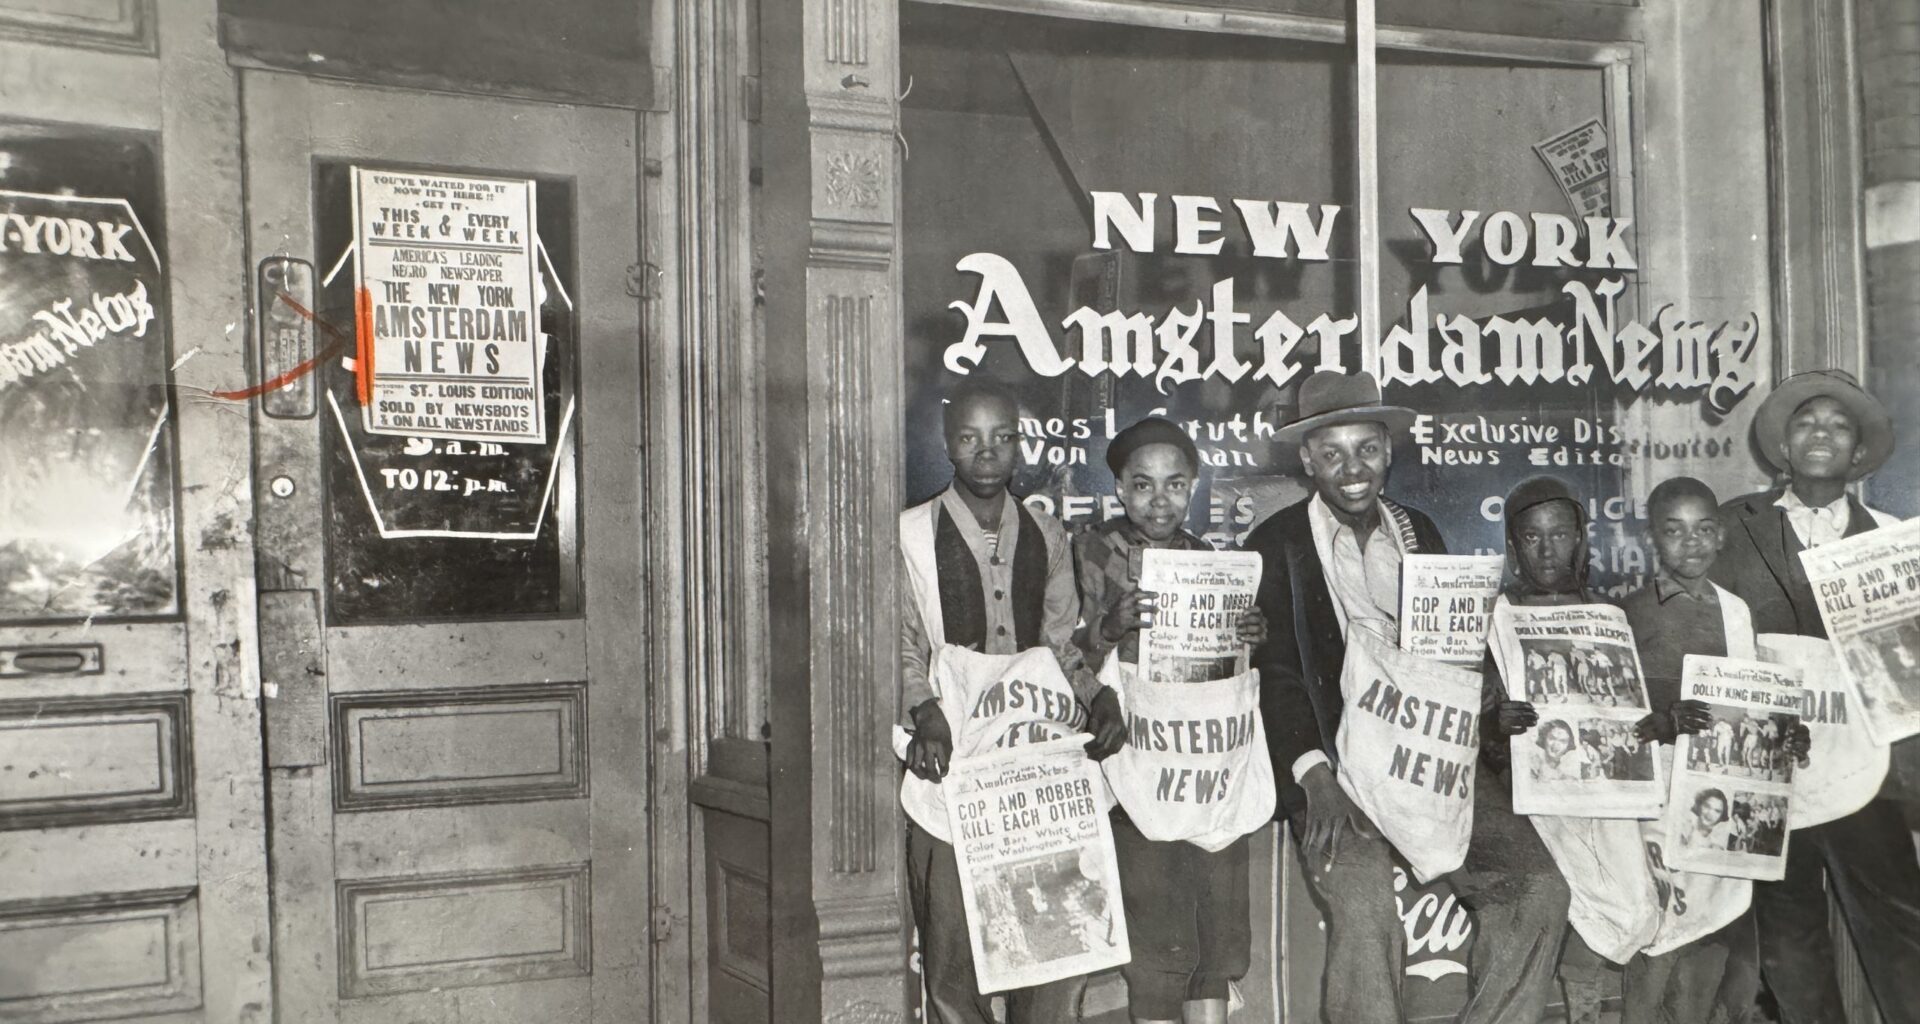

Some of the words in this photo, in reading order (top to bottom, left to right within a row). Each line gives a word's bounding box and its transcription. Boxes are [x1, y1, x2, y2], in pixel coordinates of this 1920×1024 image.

[373, 175, 414, 187] YOU'VE
[420, 180, 464, 190] WAITED
[469, 183, 490, 192] FOR
[495, 185, 506, 194] IT
[394, 187, 421, 195] NOW
[426, 189, 446, 198] IT'S
[453, 191, 483, 201] HERE
[372, 222, 430, 239] WEEK
[462, 227, 519, 244] WEEK
[380, 207, 420, 224] THIS
[439, 215, 451, 237] &
[468, 213, 509, 229] EVERY
[1090, 191, 1341, 261] NEW
[1409, 207, 1638, 270] YORK
[392, 249, 448, 265] AMERICA'S
[459, 252, 503, 268] LEADING
[392, 264, 427, 278] NEGRO
[440, 267, 503, 282] NEWSPAPER
[383, 281, 411, 303] THE
[428, 283, 460, 306] NEW
[477, 285, 514, 307] YORK
[375, 305, 527, 342] AMSTERDAM
[404, 340, 500, 375] NEWS
[409, 384, 434, 398] ST.
[438, 385, 476, 399] LOUIS
[481, 386, 534, 400] EDITION
[379, 401, 415, 414] SOLD
[425, 403, 443, 415] BY
[455, 403, 530, 418] NEWSBOYS
[393, 415, 413, 427] ON
[417, 415, 441, 428] ALL
[444, 417, 529, 432] NEWSTANDS
[1017, 417, 1091, 440] mes
[1409, 414, 1559, 445] Exclusive
[1020, 440, 1087, 466] Von
[1421, 446, 1501, 466] News
[381, 468, 418, 490] TO
[1820, 578, 1847, 598] COP
[1857, 567, 1885, 588] AND
[1189, 594, 1215, 611] AND
[1412, 596, 1440, 614] COP
[1449, 597, 1475, 614] AND
[1825, 594, 1856, 614] KILL
[1863, 581, 1900, 603] EACH
[1190, 613, 1222, 630] EACH
[1411, 615, 1440, 632] KILL
[1449, 615, 1483, 633] EACH
[1692, 683, 1722, 698] DOLLY
[1725, 687, 1749, 701] KING
[1750, 690, 1771, 705] HITS
[1388, 744, 1472, 800] NEWS
[1156, 767, 1230, 804] NEWS
[958, 800, 987, 821] COP
[998, 792, 1027, 813] AND
[1035, 778, 1092, 805] ROBBER
[961, 818, 994, 841] KILL
[1003, 808, 1041, 832] EACH
[1049, 797, 1096, 822] OTHER
[965, 842, 995, 854] Color
[1036, 826, 1071, 839] White
